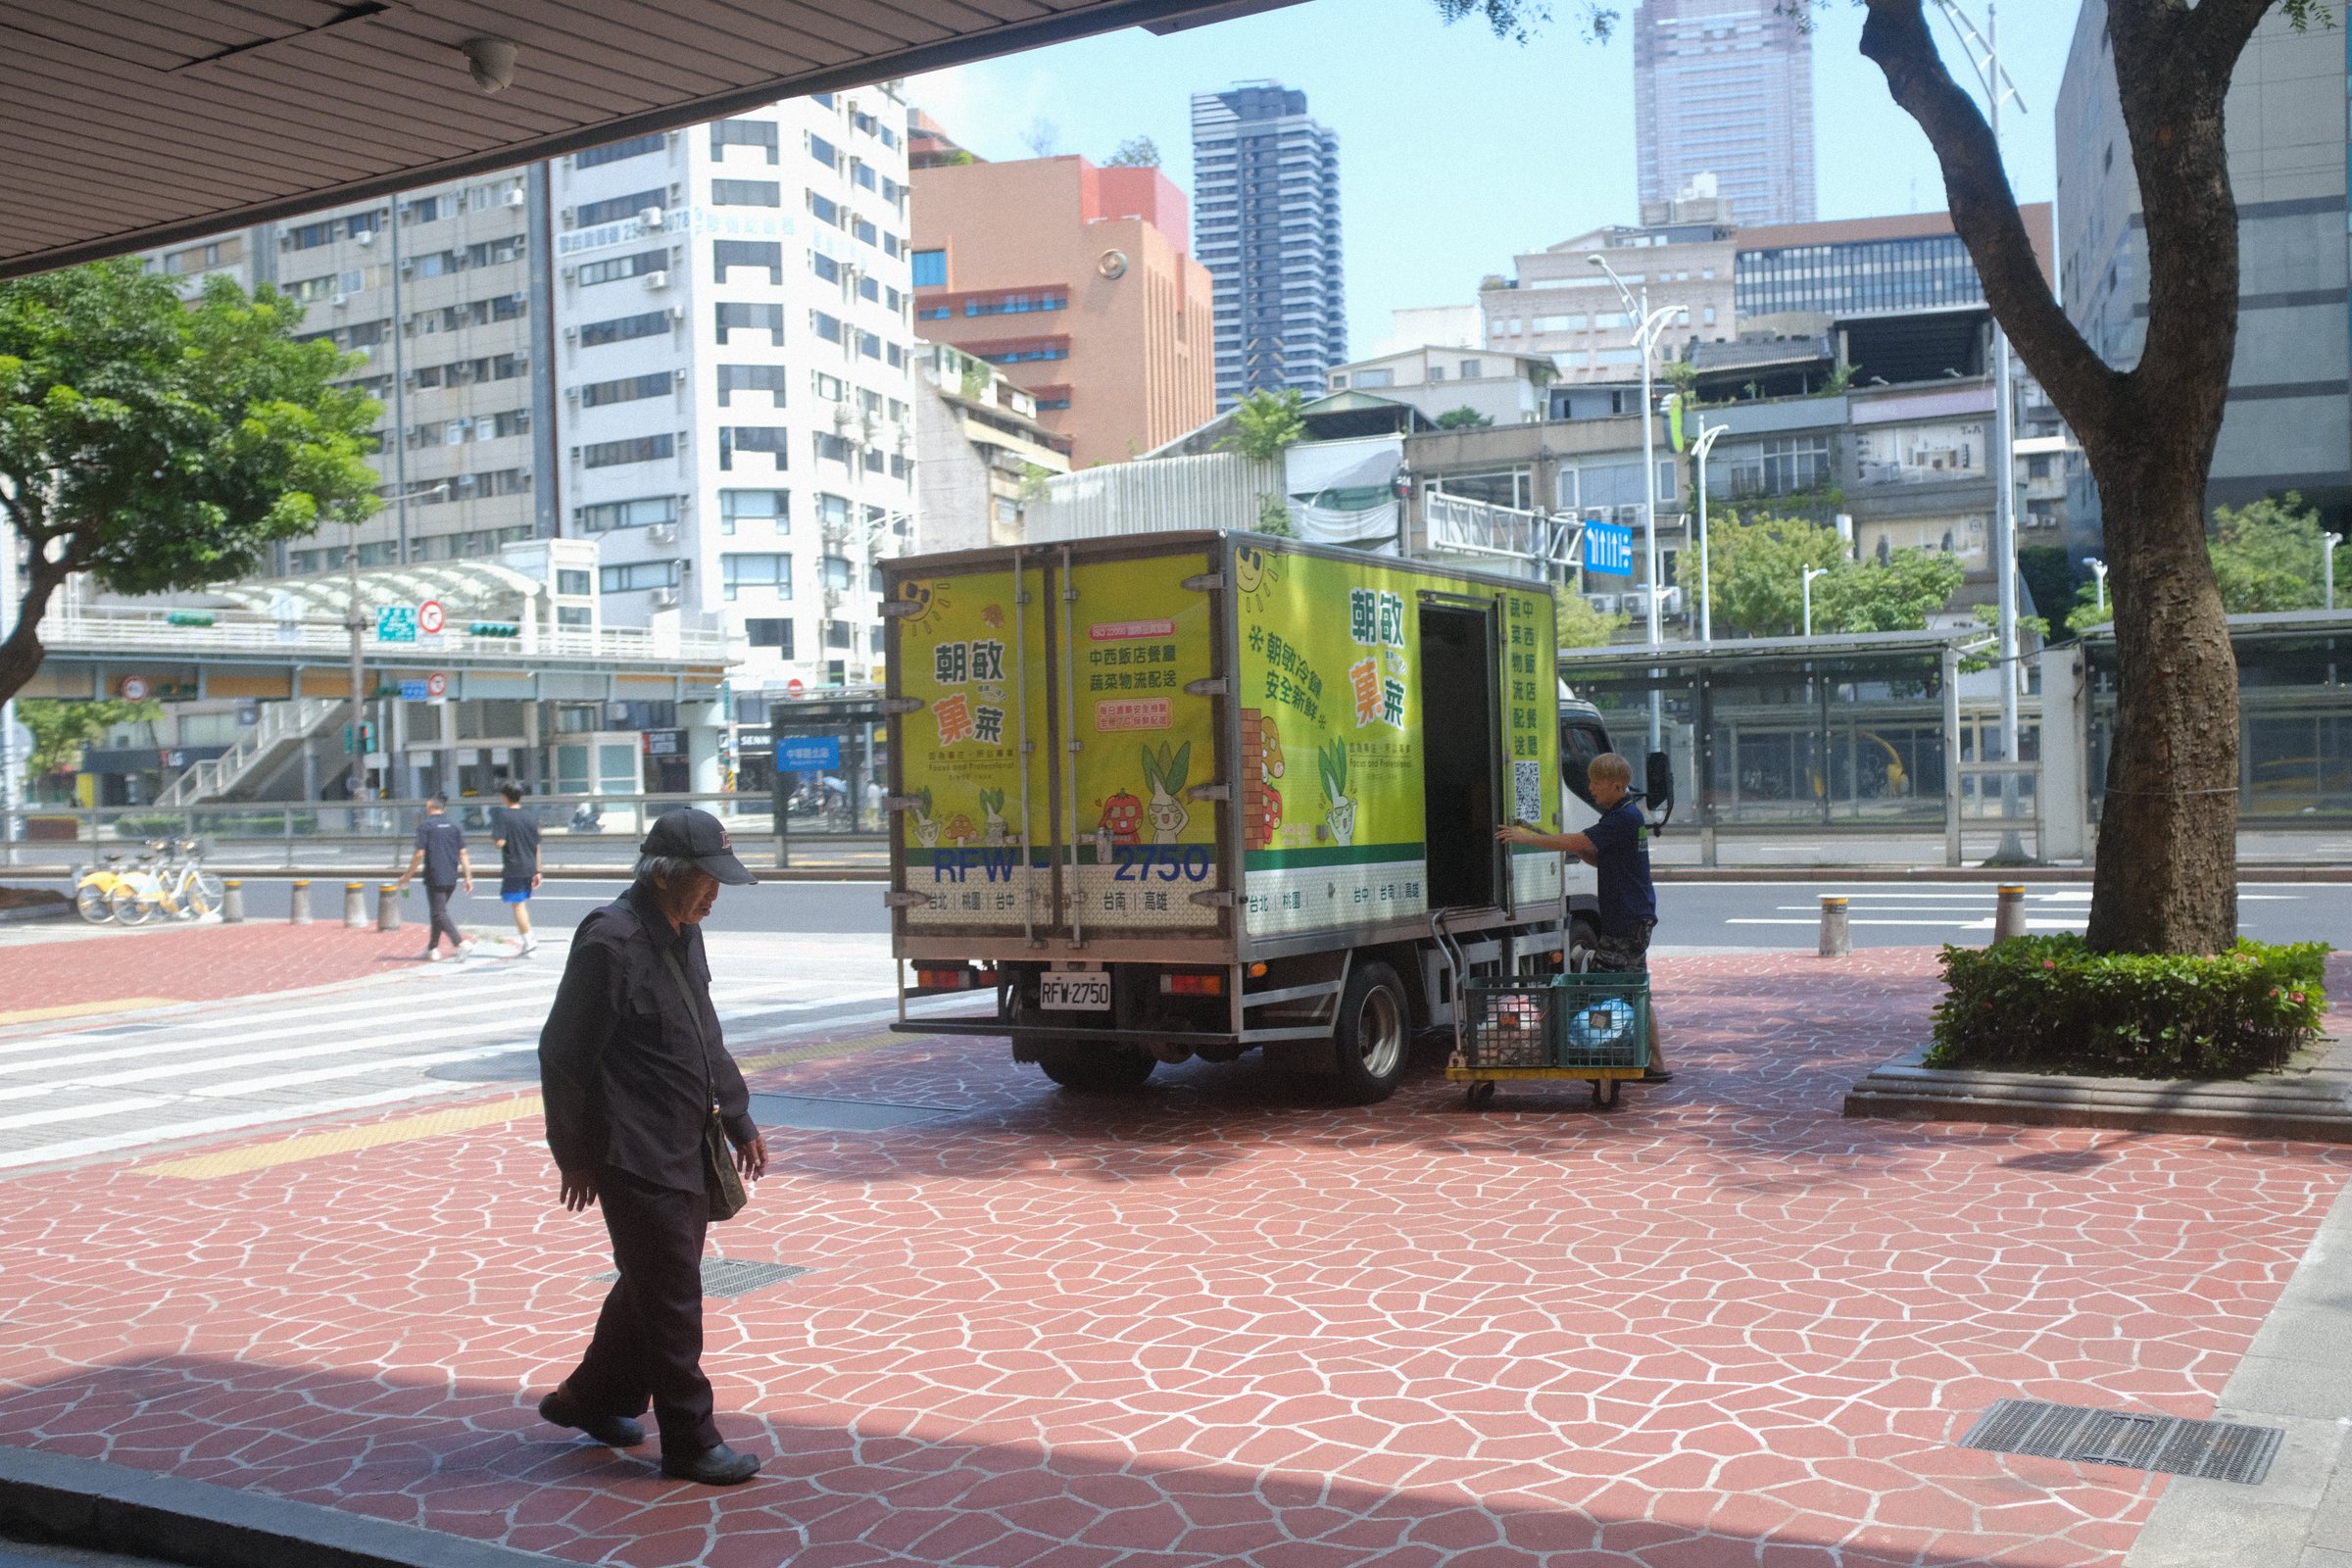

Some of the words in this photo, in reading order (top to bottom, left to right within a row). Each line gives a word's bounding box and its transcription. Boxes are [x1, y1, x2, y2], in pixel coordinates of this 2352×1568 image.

[1350, 590, 1404, 646] 朝敏
[935, 639, 1004, 684] 朝敏
[1089, 645, 1176, 665] 中西飯店餐廳
[1090, 670, 1177, 692] 蔬菜物流配送
[1265, 670, 1318, 721] 安全新鮮
[1114, 845, 1209, 881] 2750
[929, 892, 947, 909] 台北
[961, 892, 980, 909] 桃園
[996, 892, 1015, 909] 台中
[1103, 891, 1126, 910] 台南
[1145, 891, 1167, 910] 高雄
[1250, 894, 1269, 913] 台北
[1282, 891, 1301, 910] 桃園
[1354, 886, 1369, 904] 台中
